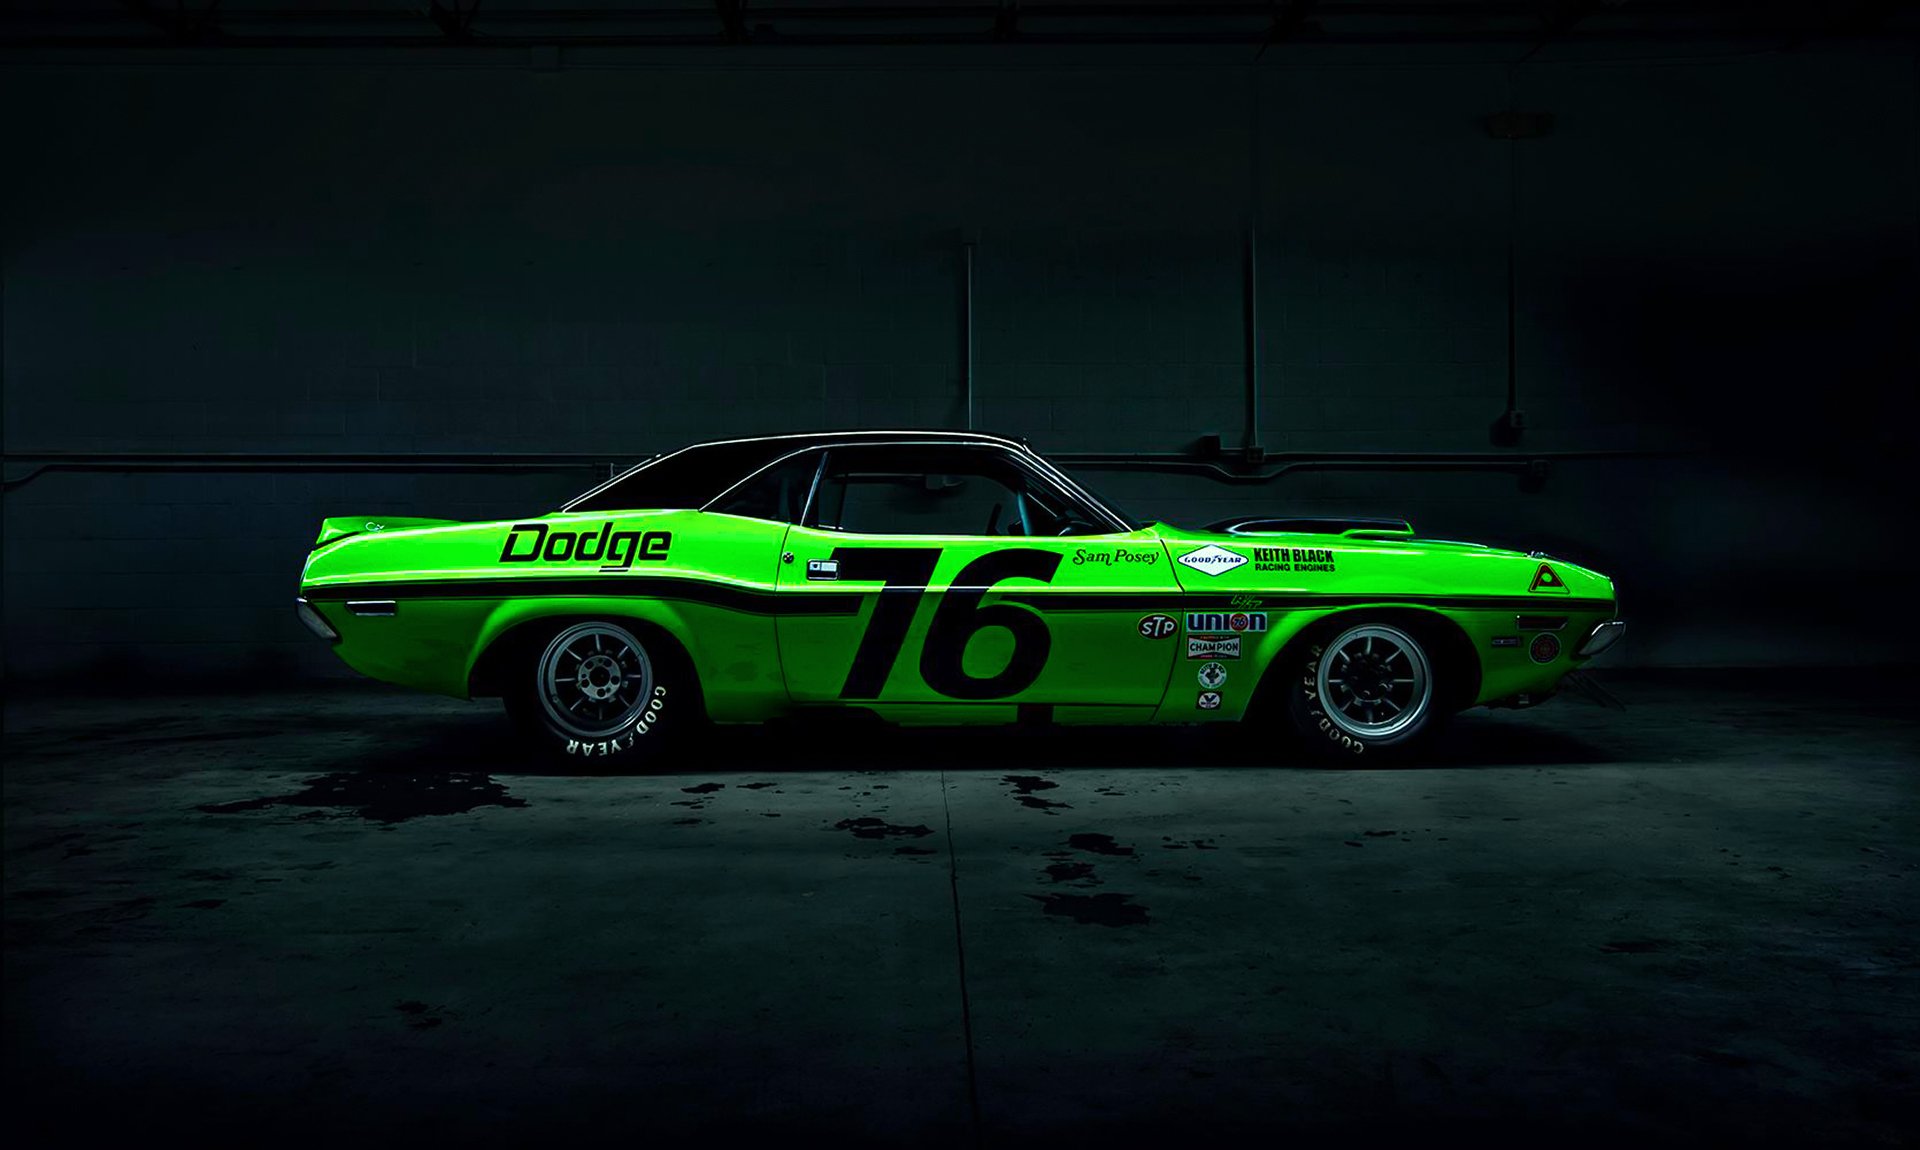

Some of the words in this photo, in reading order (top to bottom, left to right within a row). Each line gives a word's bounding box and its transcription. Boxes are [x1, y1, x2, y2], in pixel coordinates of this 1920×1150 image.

[499, 522, 672, 572] Dodge
[1072, 549, 1112, 566] Sam
[1114, 549, 1159, 565] Posey
[1253, 548, 1291, 562] KEITH
[1292, 549, 1334, 563] BLACK
[1294, 564, 1336, 572] ENGINES
[831, 547, 1064, 700] 76
[1189, 642, 1239, 652] CHAMPION
